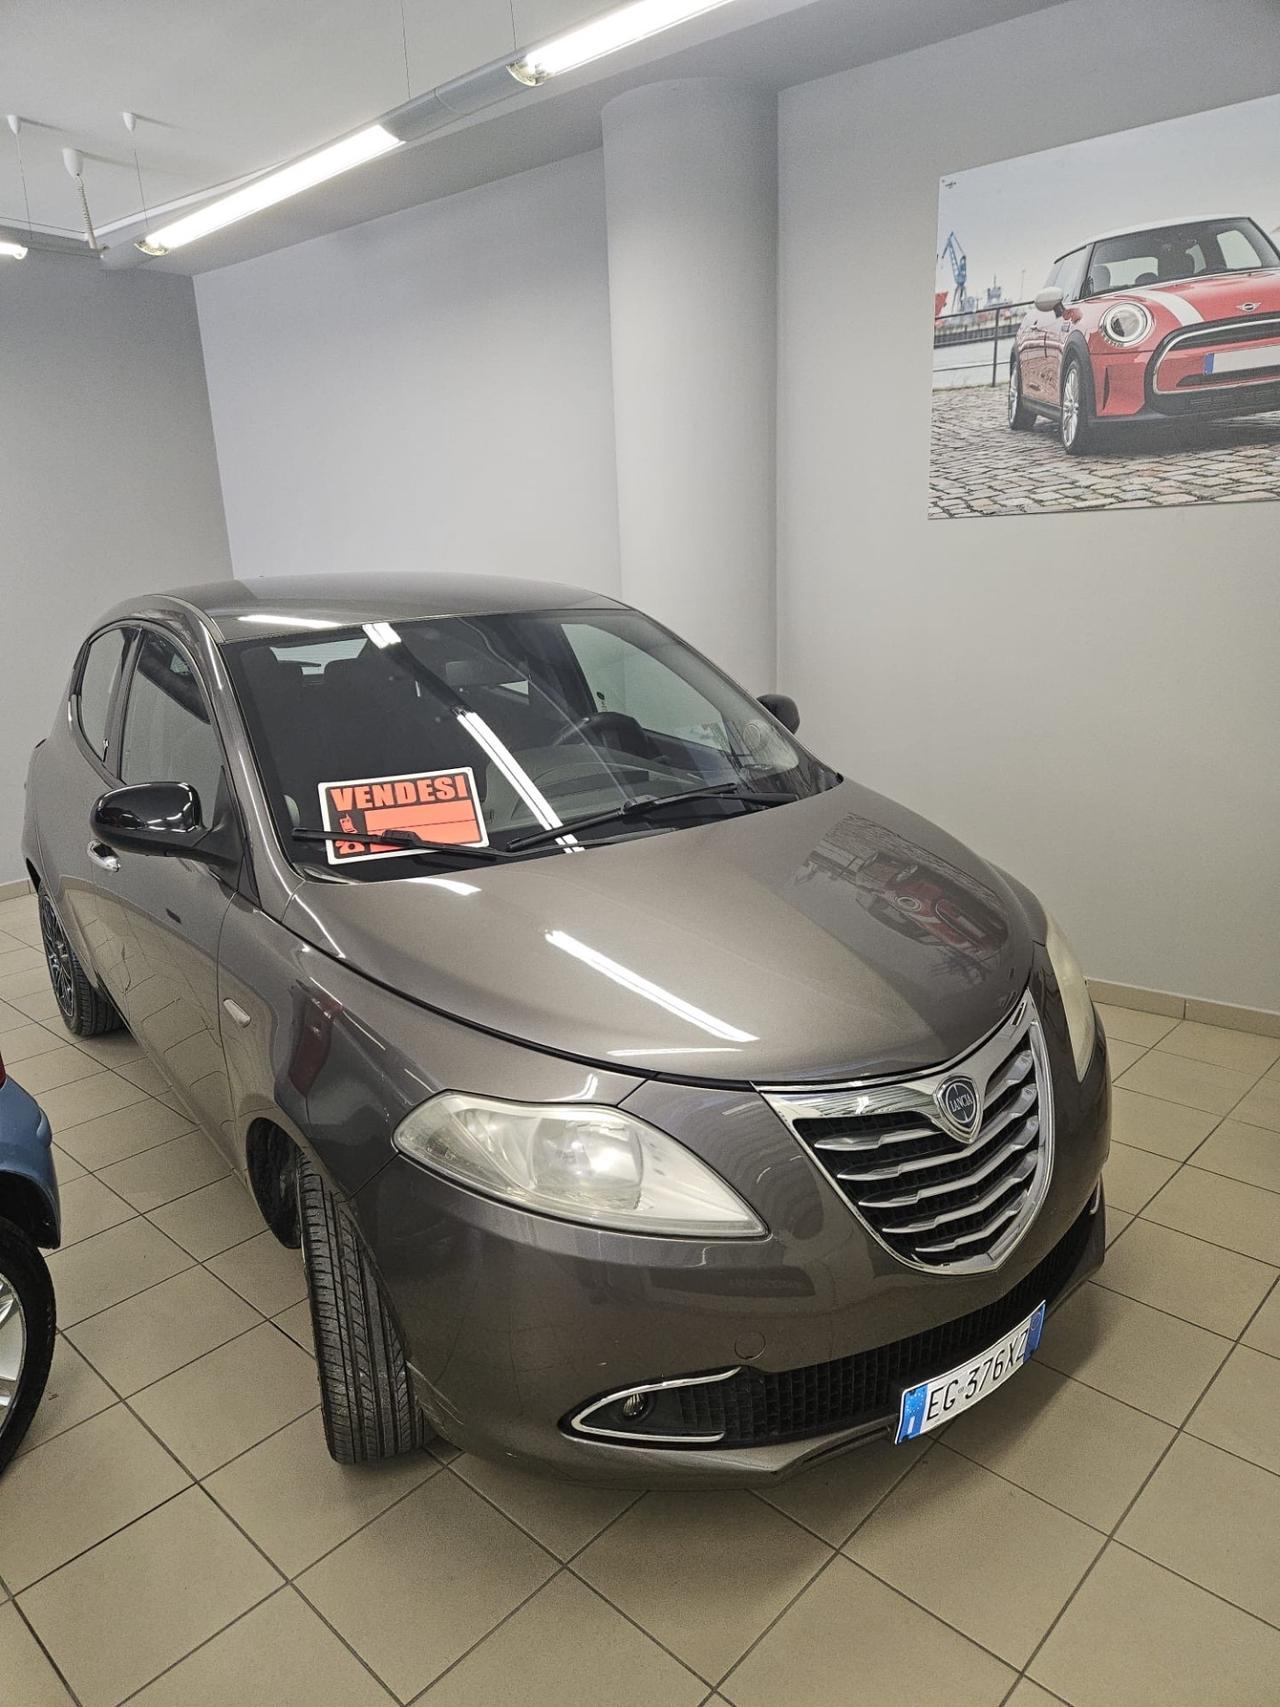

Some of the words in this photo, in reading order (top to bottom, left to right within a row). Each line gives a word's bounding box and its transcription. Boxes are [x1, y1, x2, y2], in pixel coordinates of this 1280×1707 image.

[330, 775, 468, 812] VENDESI
[949, 1093, 973, 1113] LANCIA
[926, 1379, 958, 1421] EG
